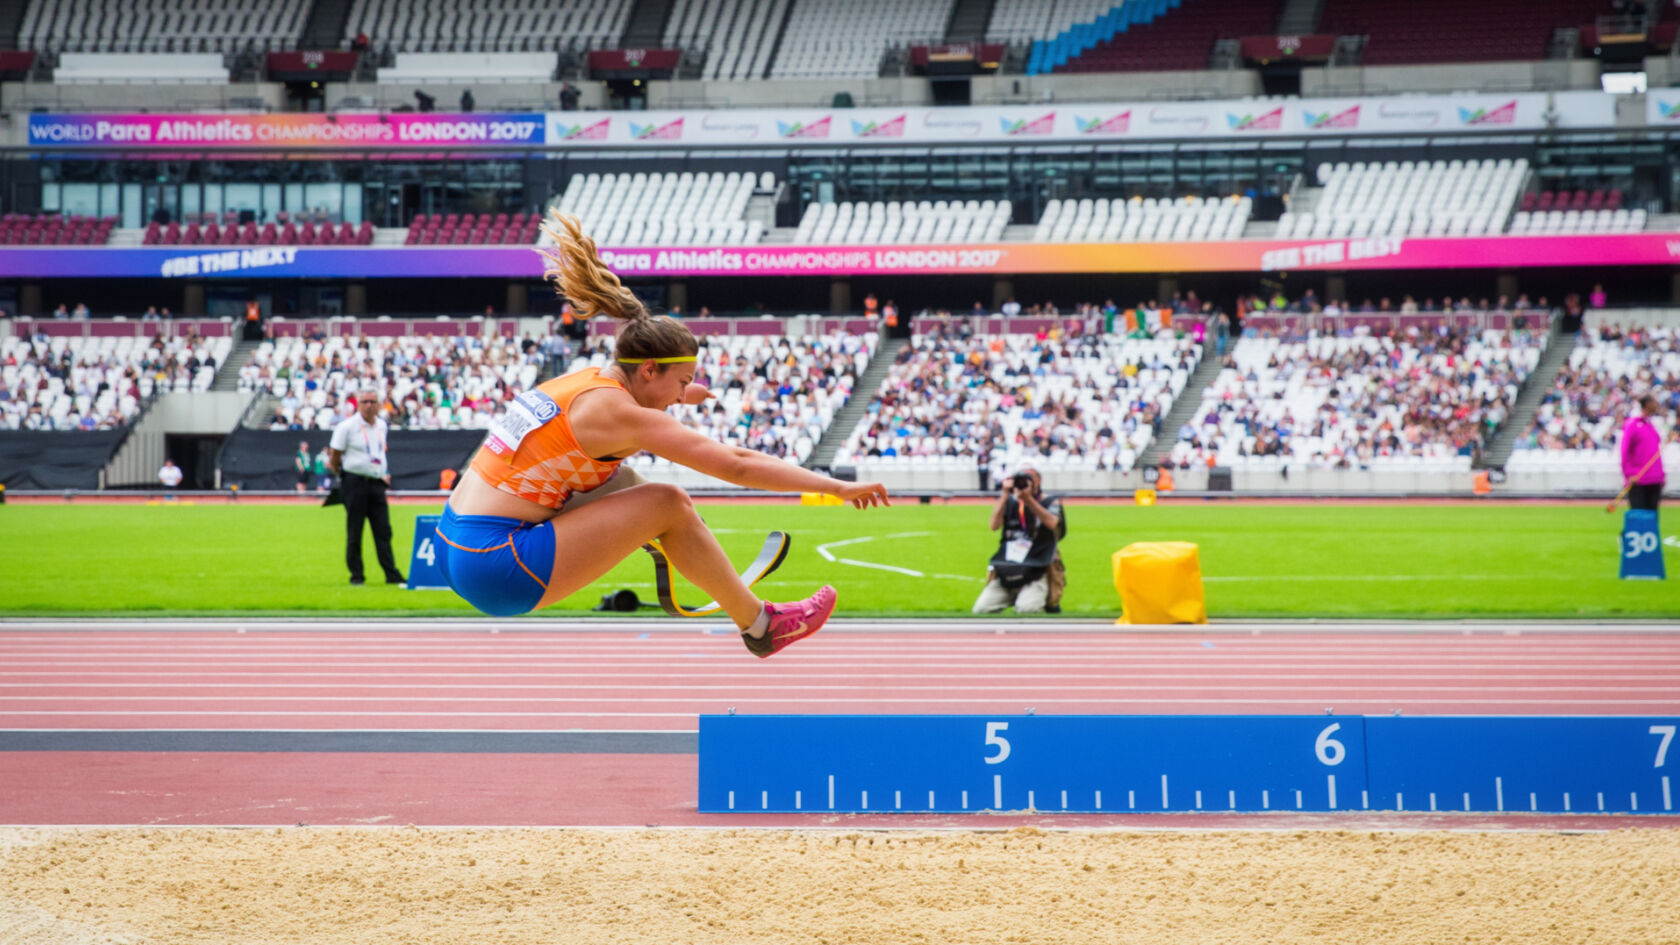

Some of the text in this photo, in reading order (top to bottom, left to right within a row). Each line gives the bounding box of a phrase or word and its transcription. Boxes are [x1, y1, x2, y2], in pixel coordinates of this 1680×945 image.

[31, 124, 94, 141] WORLD
[96, 121, 150, 141] Para
[156, 118, 253, 141] Athletics
[256, 122, 394, 140] CHAMPIONSHIPS
[401, 122, 487, 141] LONDON
[161, 247, 299, 278] #BE THE NEXT
[601, 251, 651, 270] Para
[655, 248, 743, 270] Athletics
[745, 252, 871, 269] CHAMPIONSHIPS
[875, 250, 957, 269] LONDON
[1302, 242, 1345, 266] THE
[1348, 237, 1405, 260] BEST
[1624, 531, 1658, 559] 30
[984, 721, 1011, 765] 5
[1315, 722, 1346, 766] 6
[1649, 725, 1677, 768] 7
